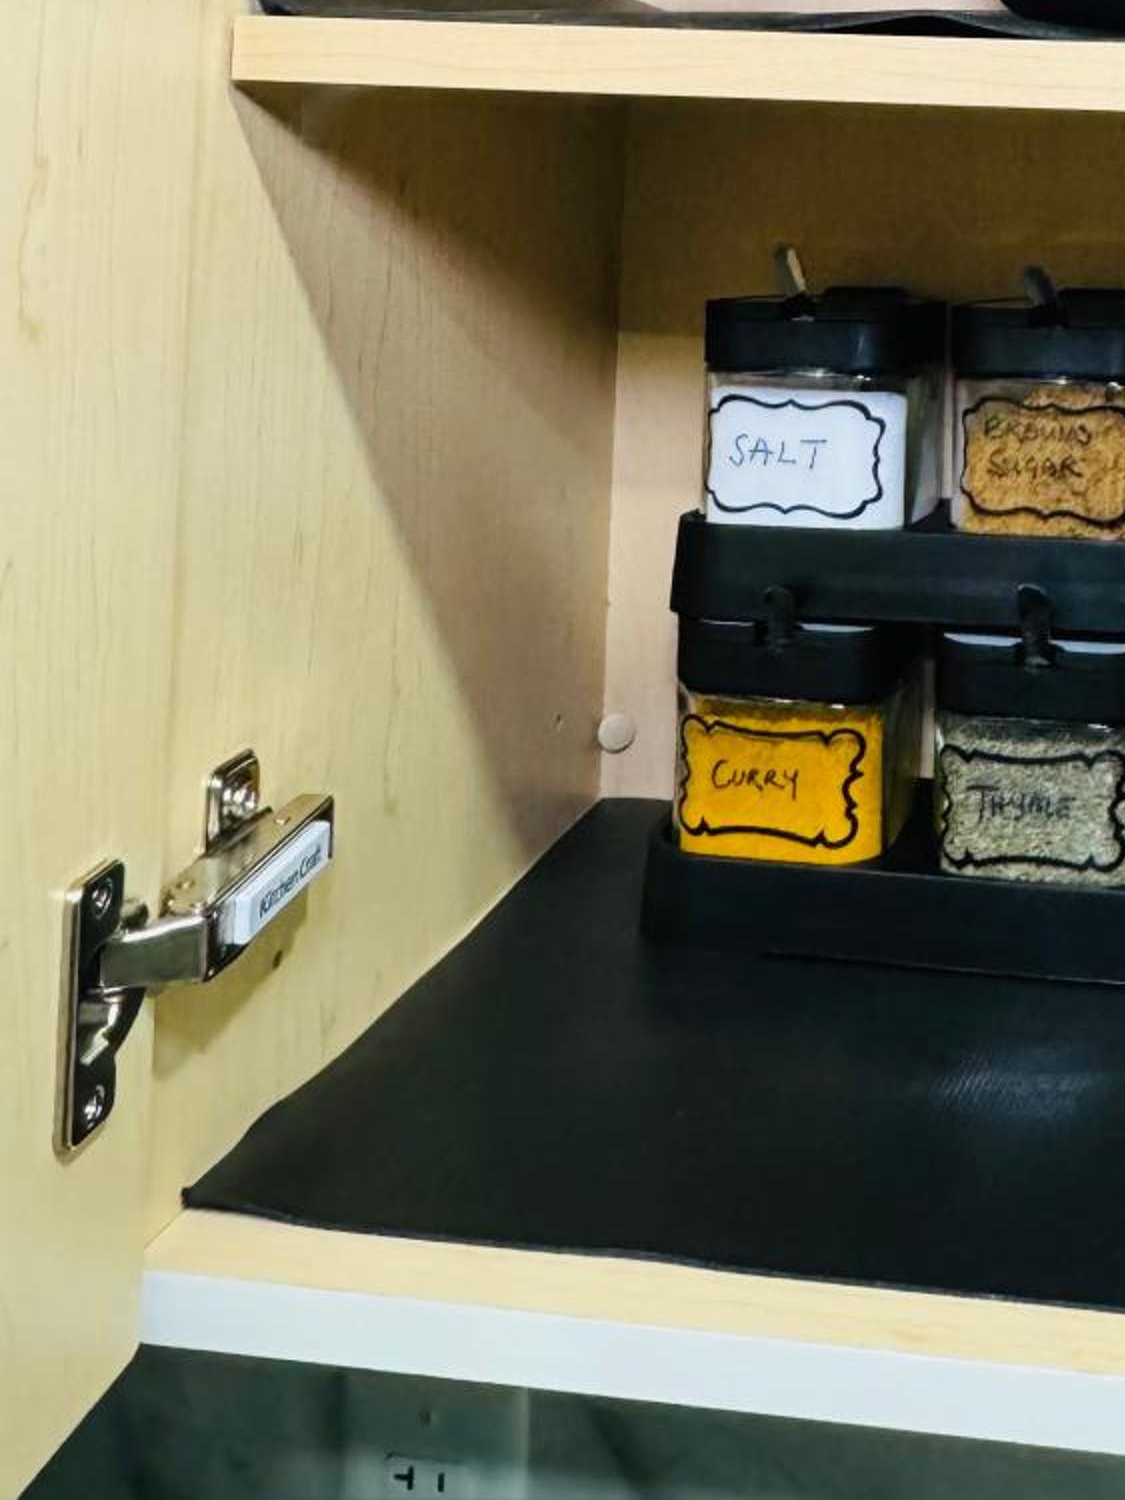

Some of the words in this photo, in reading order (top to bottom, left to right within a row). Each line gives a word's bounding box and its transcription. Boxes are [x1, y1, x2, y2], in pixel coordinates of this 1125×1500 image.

[728, 432, 828, 470] SALT
[987, 448, 1083, 481] SUGAR
[711, 759, 800, 801] CURRY
[965, 784, 1077, 823] THYME
